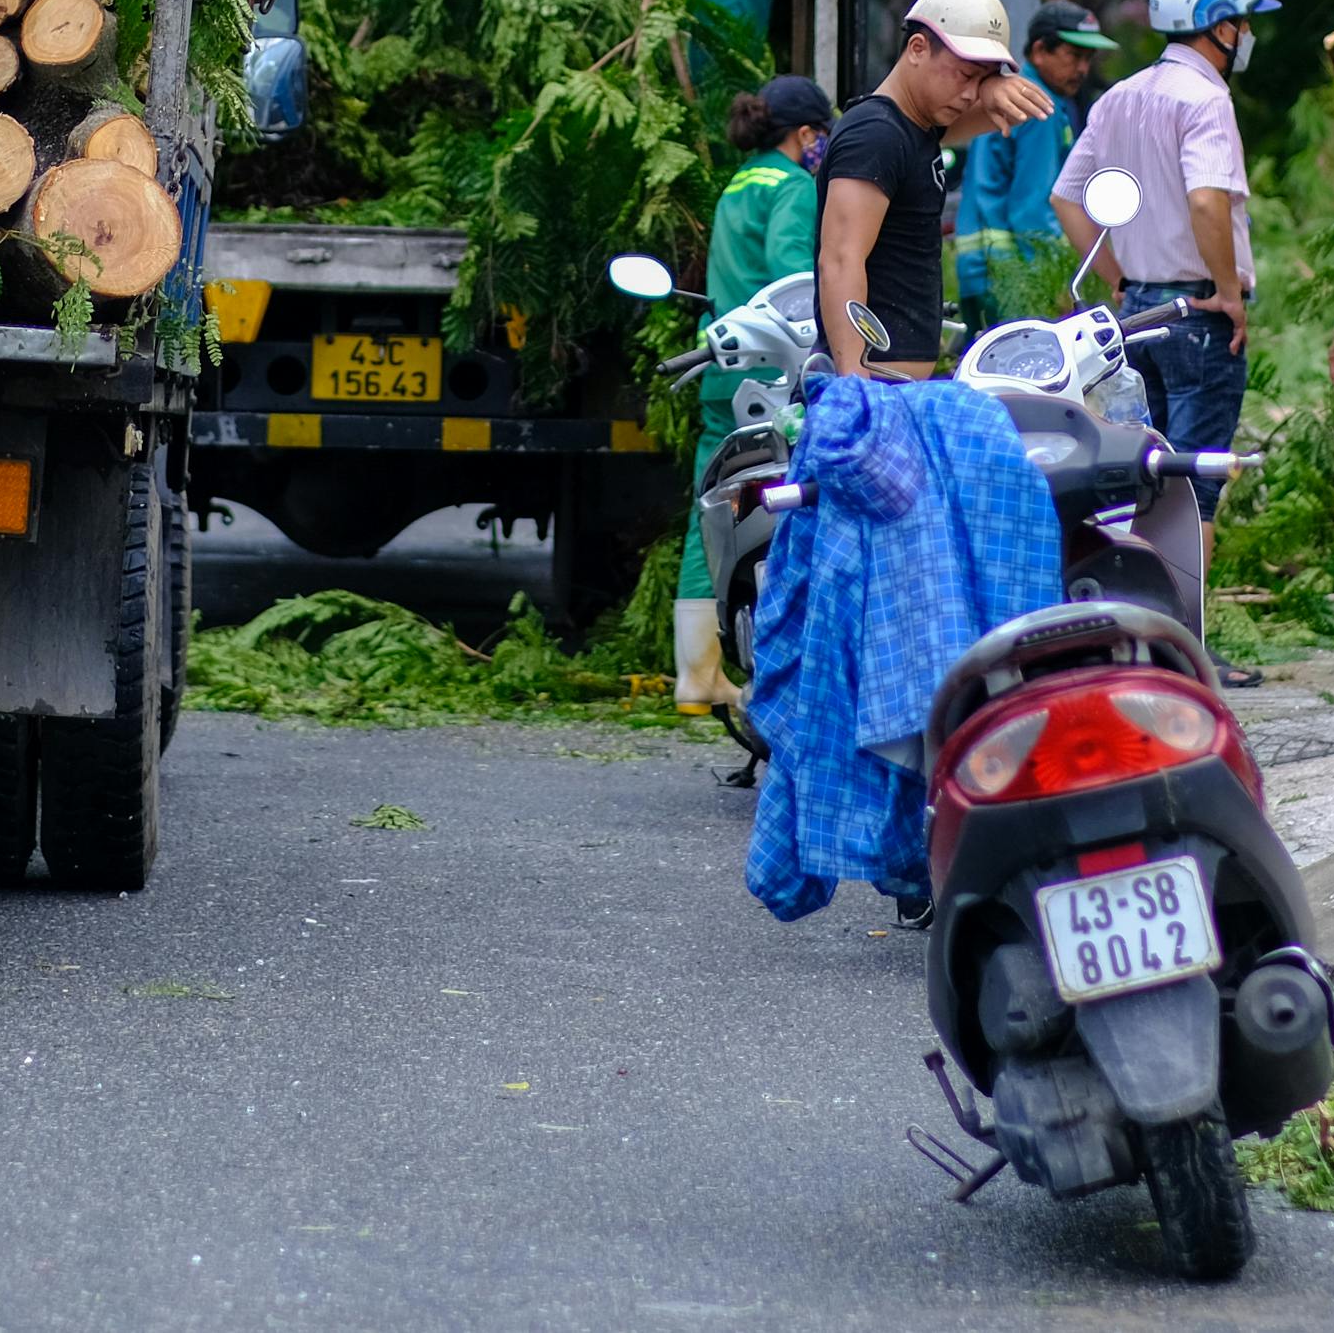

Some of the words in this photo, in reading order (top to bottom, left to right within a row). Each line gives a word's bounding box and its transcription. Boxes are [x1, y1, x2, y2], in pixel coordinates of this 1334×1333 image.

[330, 369, 427, 398] 156.43
[1069, 871, 1180, 935] 43-S8
[1077, 920, 1193, 985] 8042
